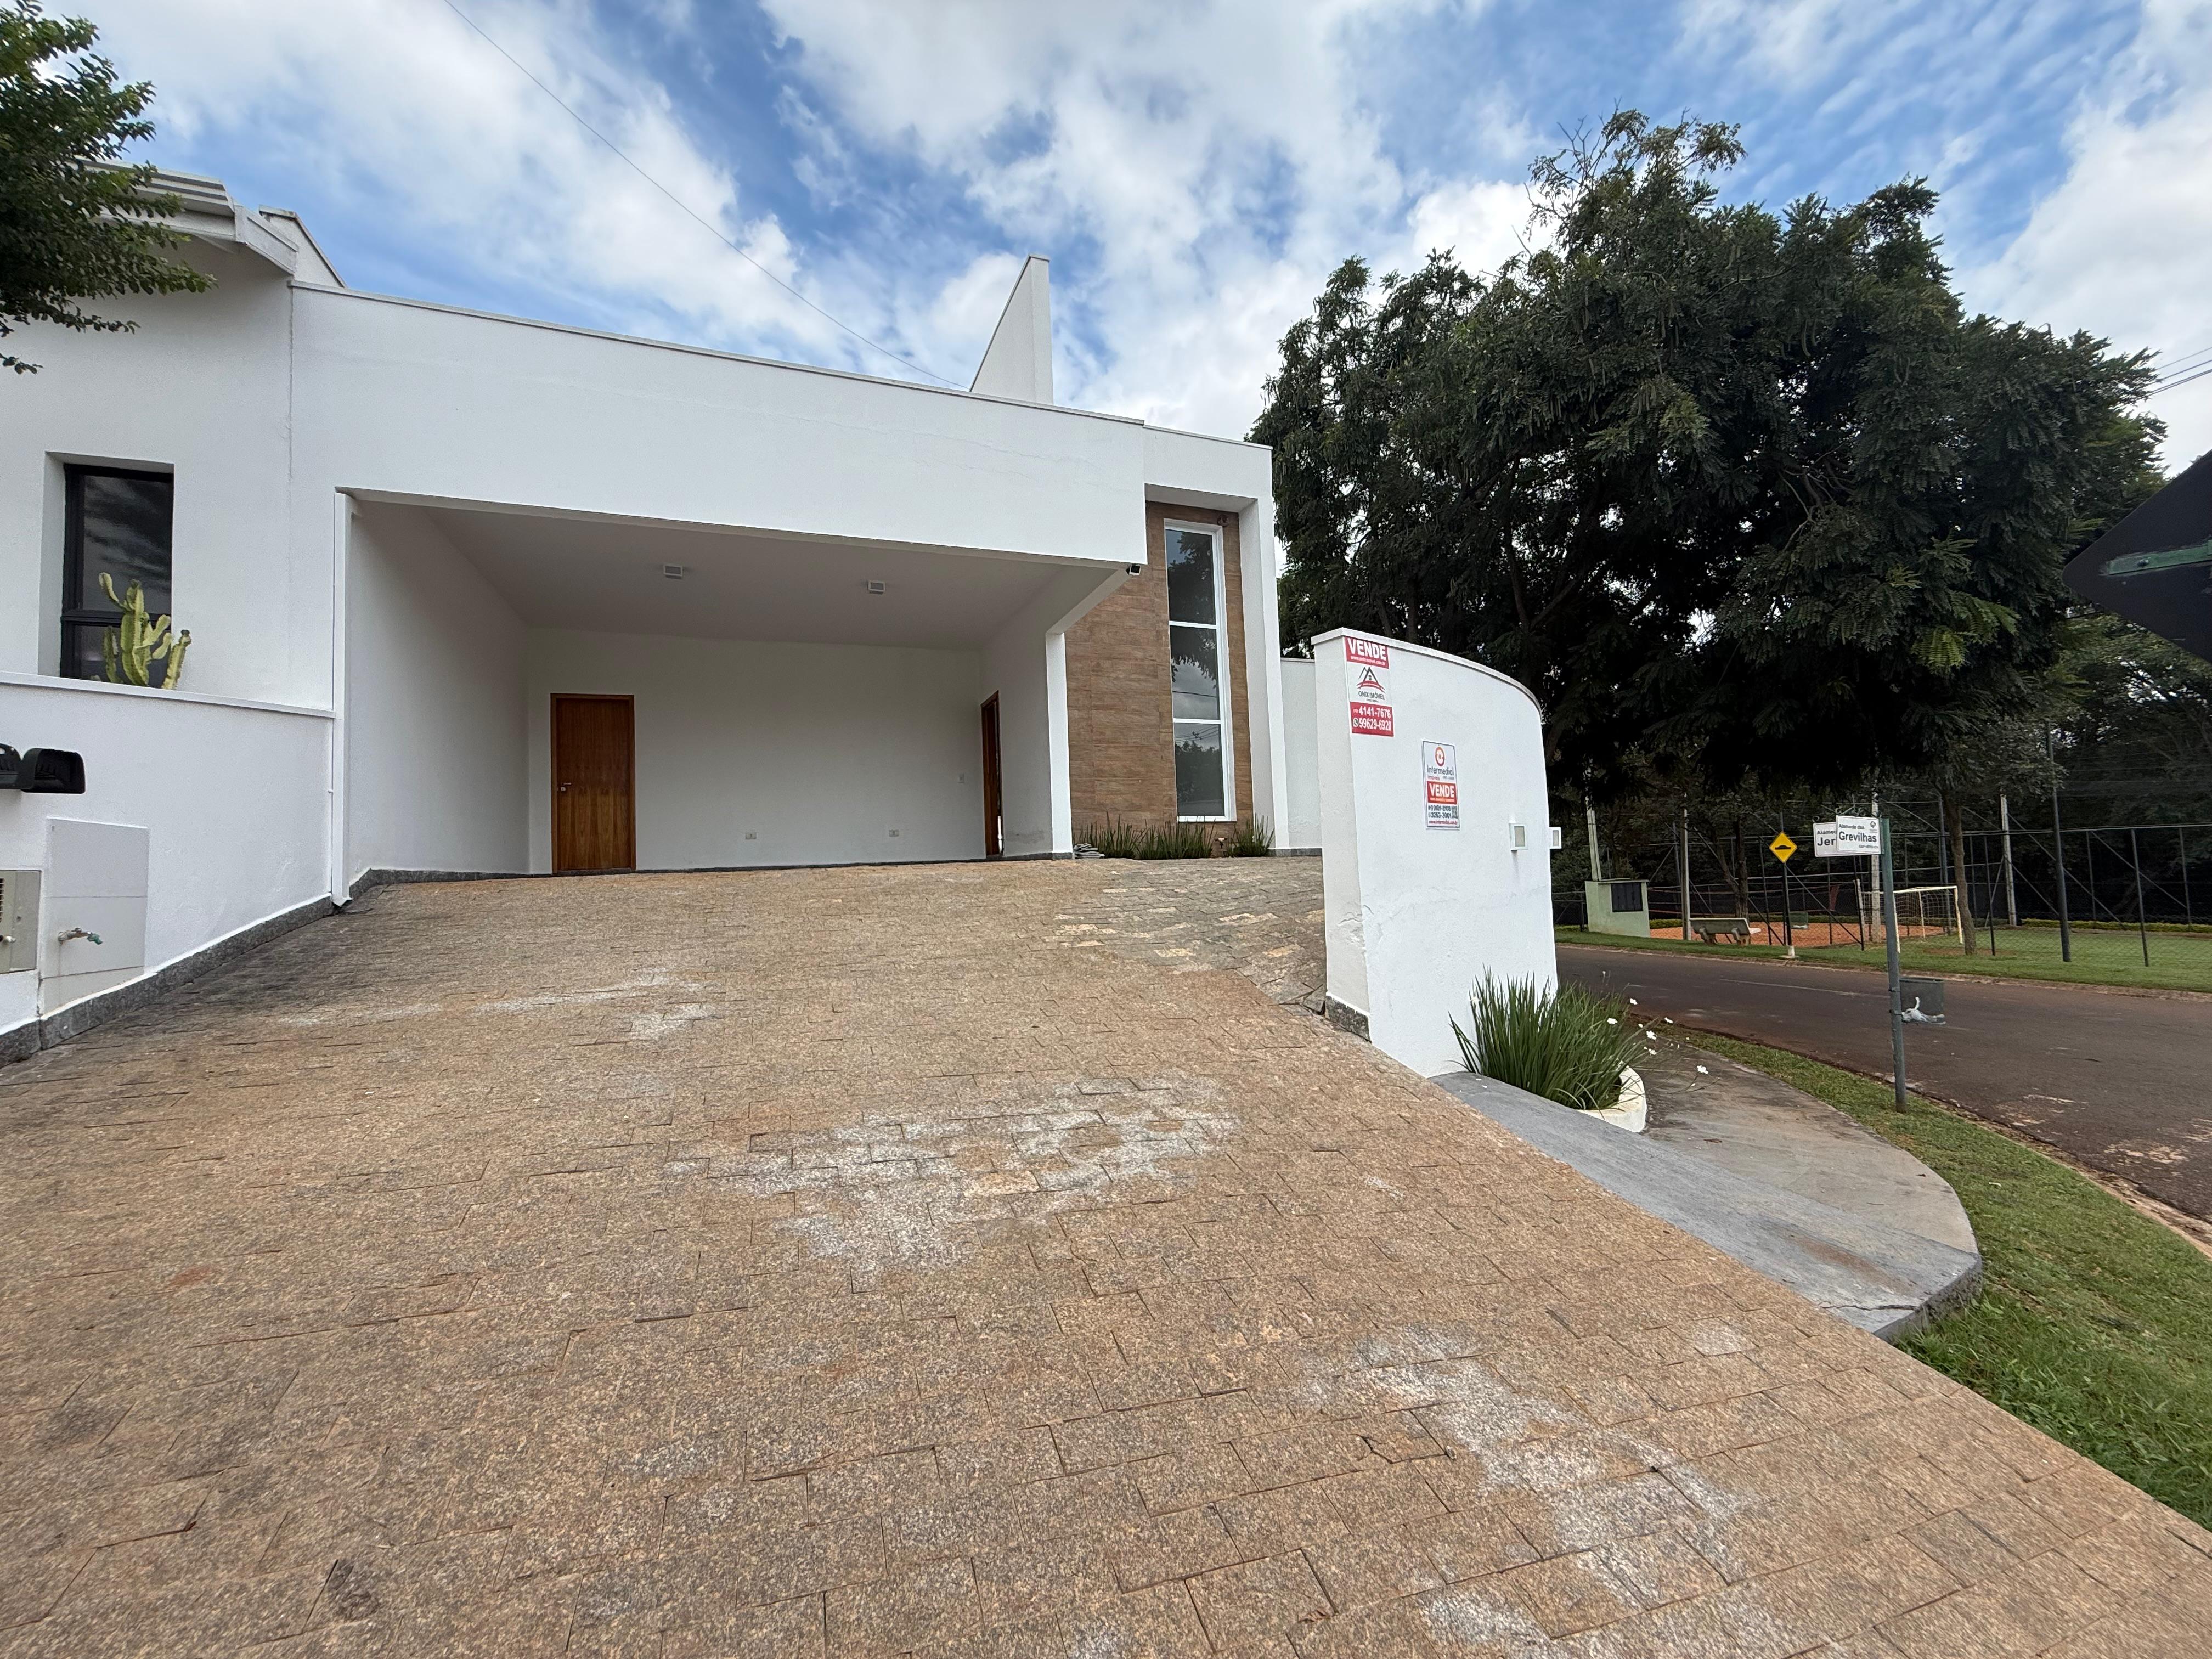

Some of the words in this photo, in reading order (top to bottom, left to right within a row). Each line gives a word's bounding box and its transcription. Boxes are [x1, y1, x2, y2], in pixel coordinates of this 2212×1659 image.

[1347, 638, 1386, 661] VENDE
[1358, 706, 1391, 719] 4141-7676
[1359, 717, 1391, 731] 99629-6920
[1427, 765, 1454, 775] Intermedial
[1429, 783, 1455, 798] VENDE
[1816, 837, 1836, 846] Jer
[1838, 831, 1877, 842] Grevilhas
